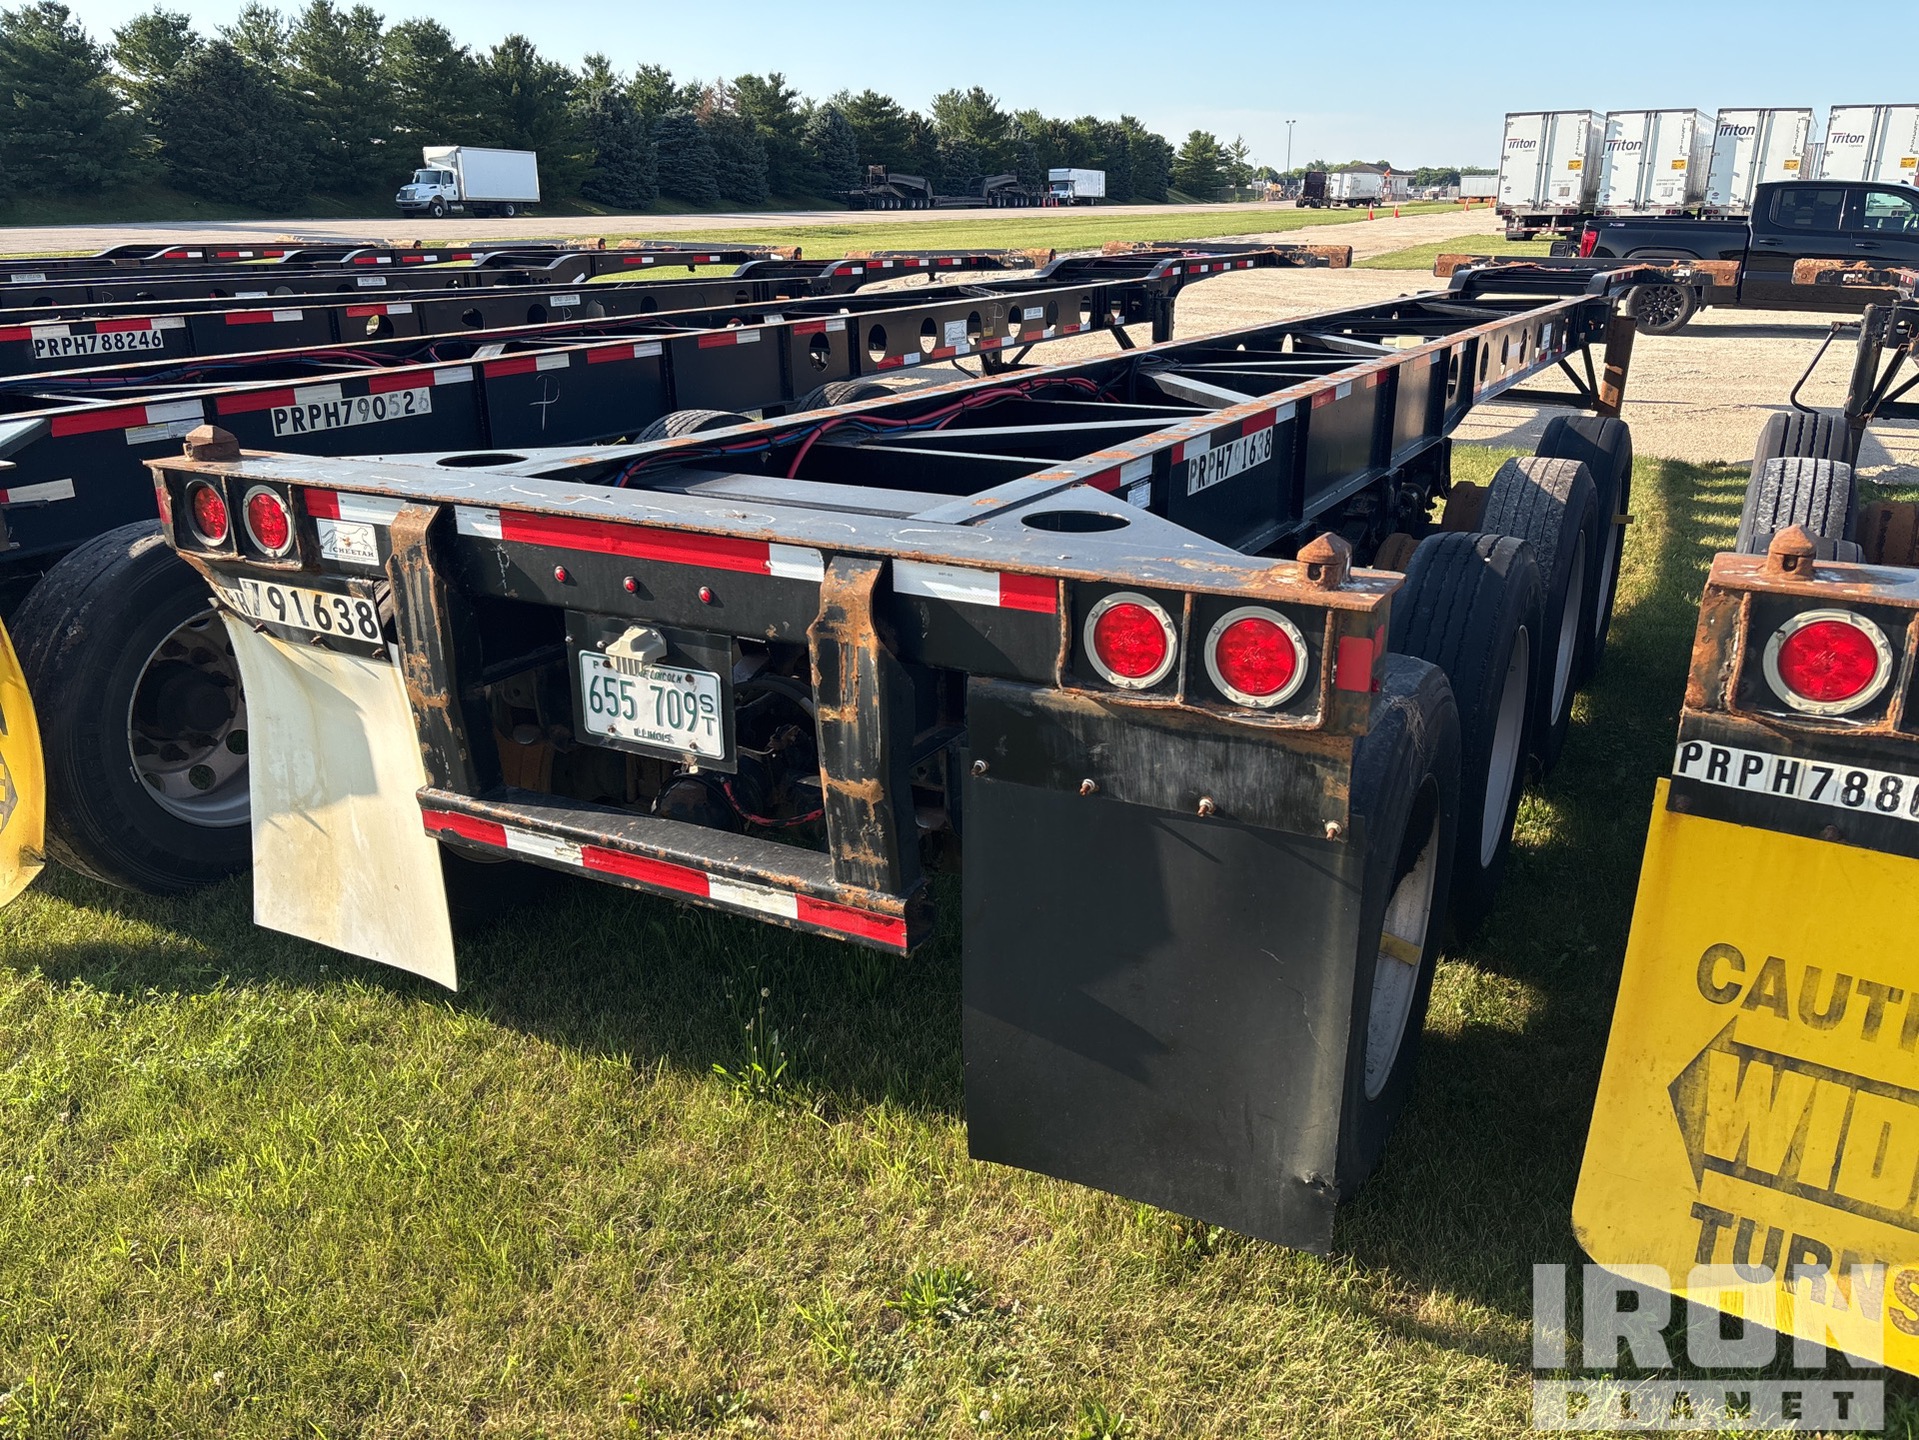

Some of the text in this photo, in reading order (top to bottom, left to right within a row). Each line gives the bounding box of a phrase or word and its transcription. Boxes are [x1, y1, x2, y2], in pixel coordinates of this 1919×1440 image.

[1719, 124, 1755, 136] Triton
[1508, 138, 1536, 149] Triton
[1606, 139, 1642, 151] Triton
[1831, 132, 1864, 144] Triton
[34, 330, 162, 358] PRPH788246
[273, 388, 430, 435] PRPH790526
[1189, 428, 1272, 493] PRPH791638
[332, 547, 374, 558] CHEETAH
[650, 669, 682, 684] LINCOLN
[589, 675, 637, 721] 655
[650, 685, 698, 733] 709
[633, 727, 673, 742] ILLINOIS
[1703, 1046, 1919, 1211] WID
[1690, 1201, 1919, 1336] TURNS
